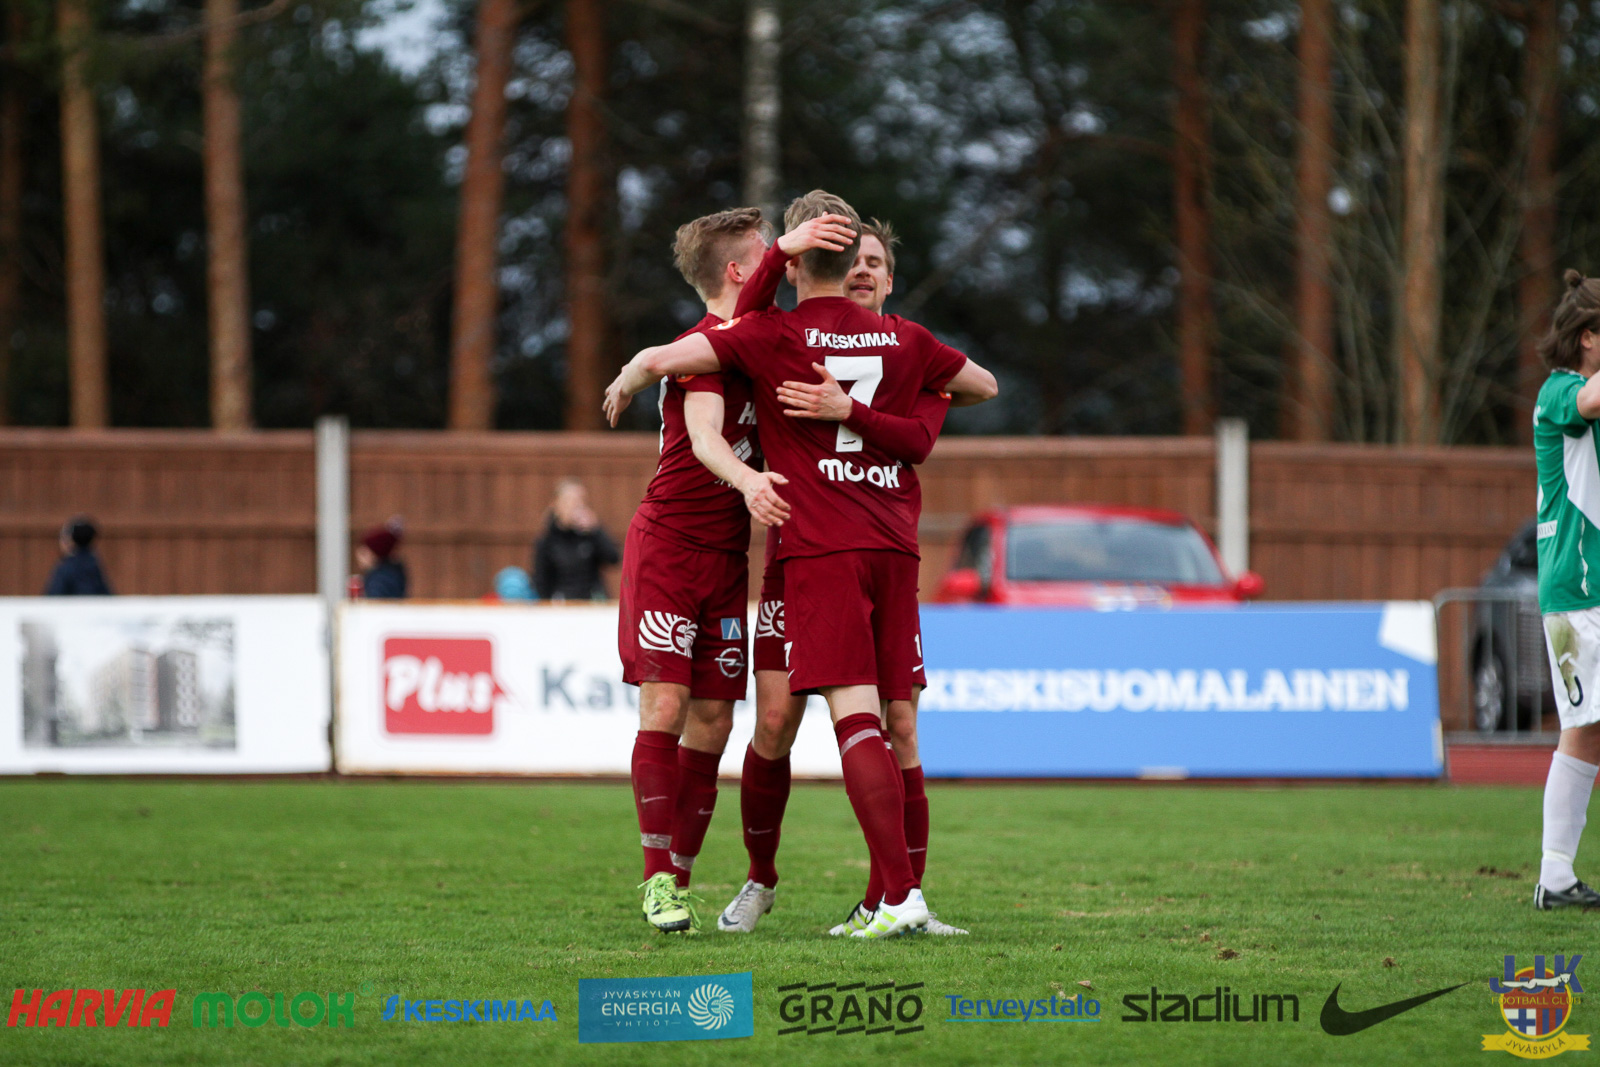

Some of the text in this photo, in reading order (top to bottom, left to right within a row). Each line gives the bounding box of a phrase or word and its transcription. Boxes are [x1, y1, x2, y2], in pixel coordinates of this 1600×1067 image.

[820, 332, 900, 349] KESKIMAA
[825, 356, 883, 453] 7
[818, 459, 900, 489] MOOK
[385, 655, 493, 713] Plus
[920, 669, 1409, 711] KESKISUOMALAINEN
